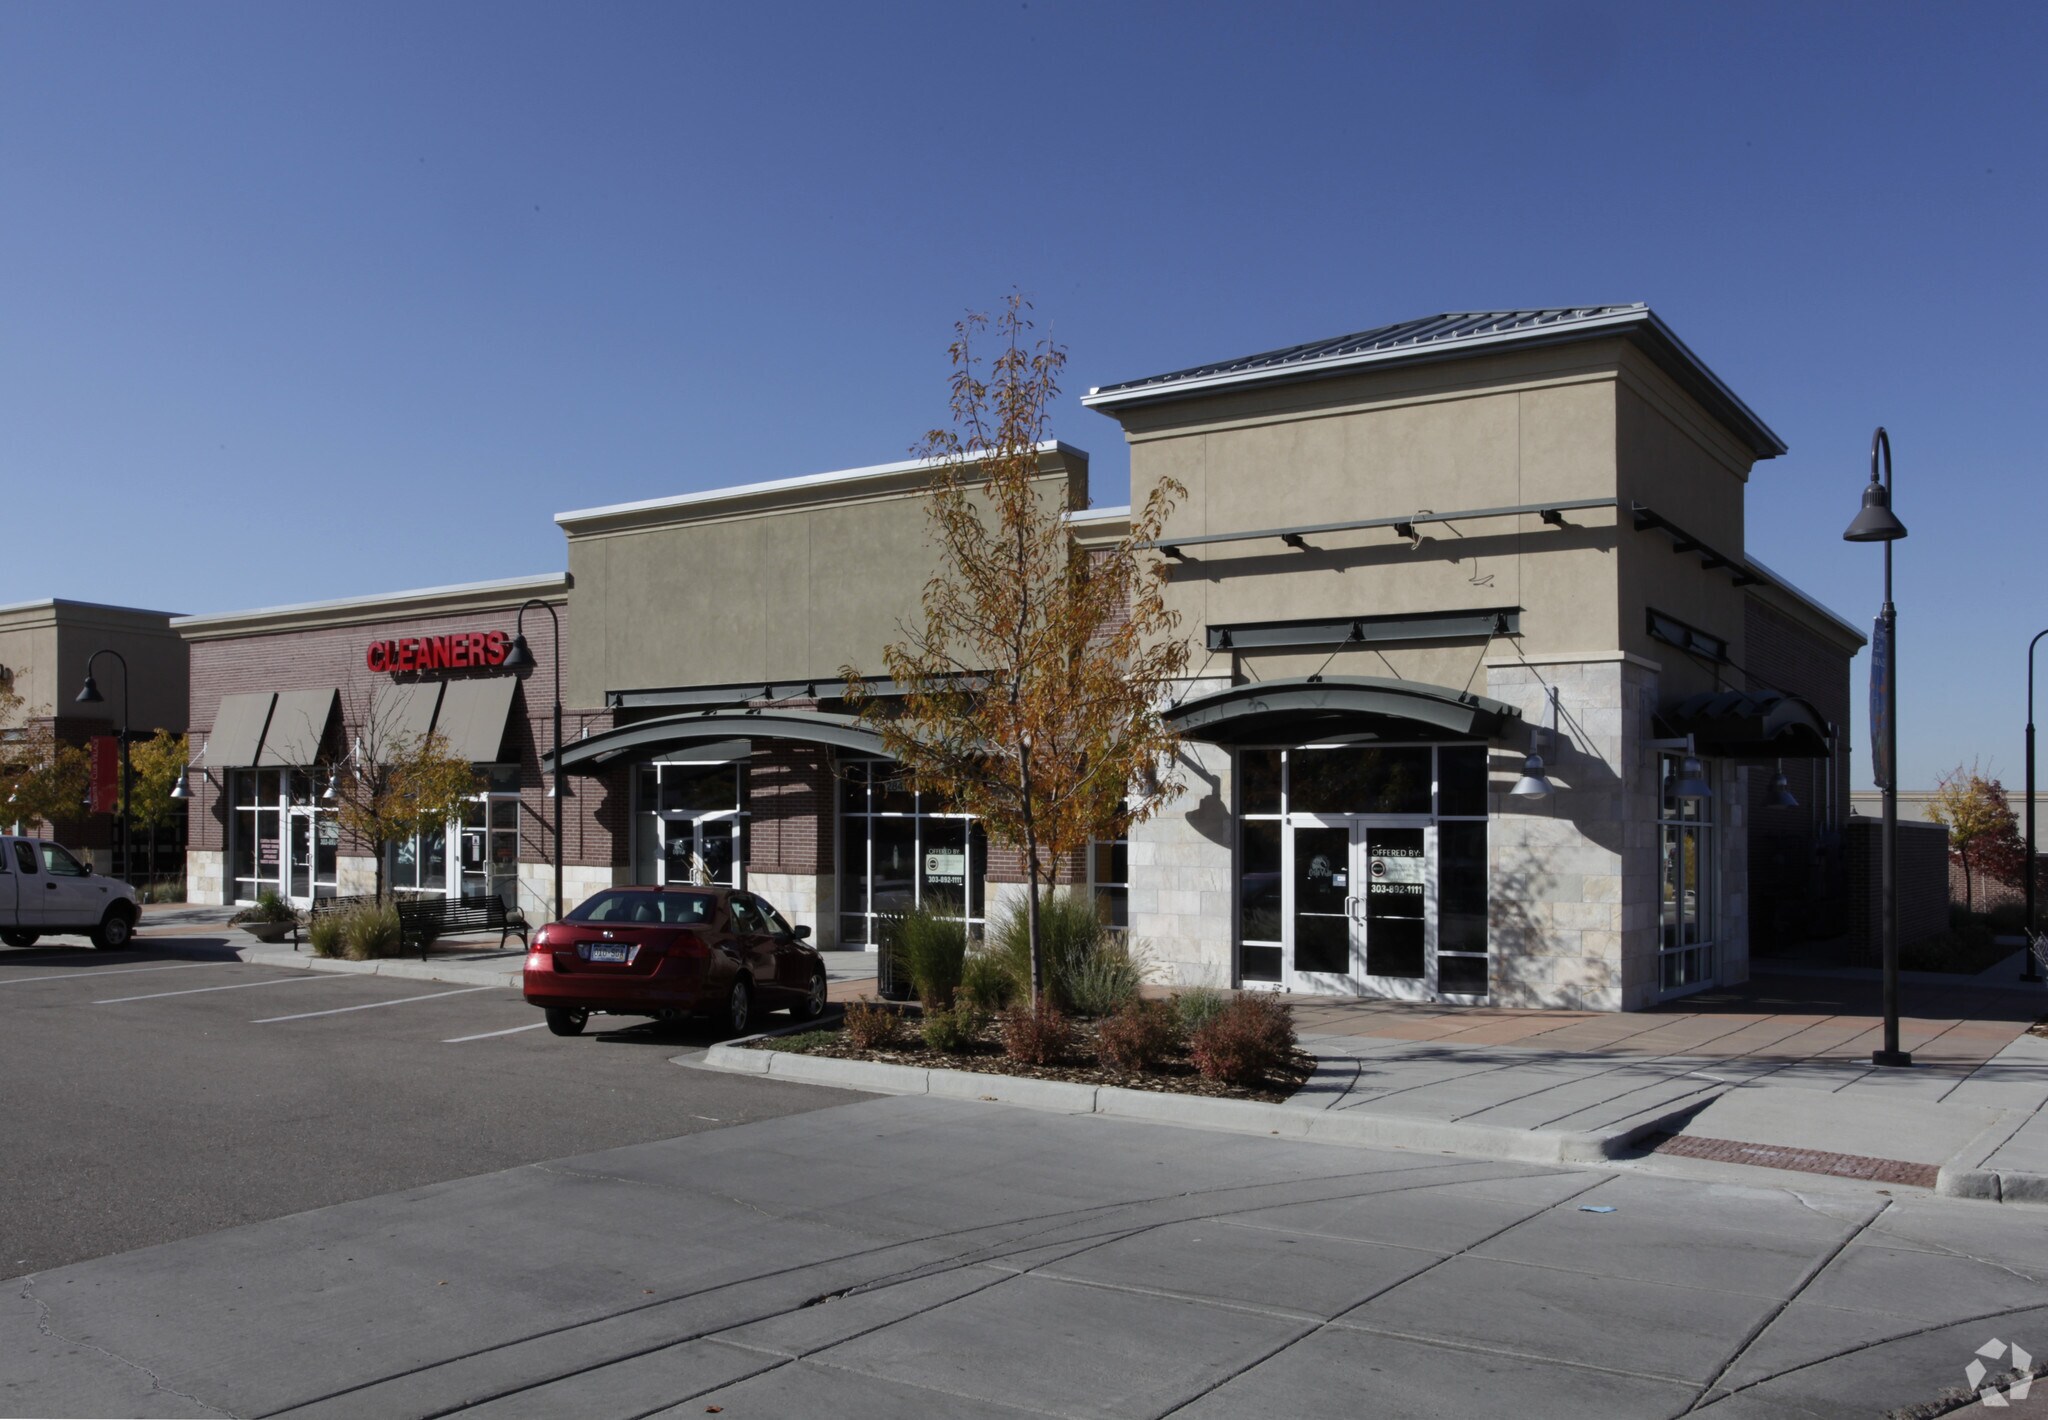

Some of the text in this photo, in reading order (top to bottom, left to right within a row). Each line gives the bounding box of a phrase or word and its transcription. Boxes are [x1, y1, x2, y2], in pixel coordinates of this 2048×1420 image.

[367, 630, 507, 672] CLEANERS
[1372, 849, 1421, 857] OFFERED BY:
[928, 876, 962, 884] 303-892-1111
[1371, 884, 1423, 894] 303-892-1111
